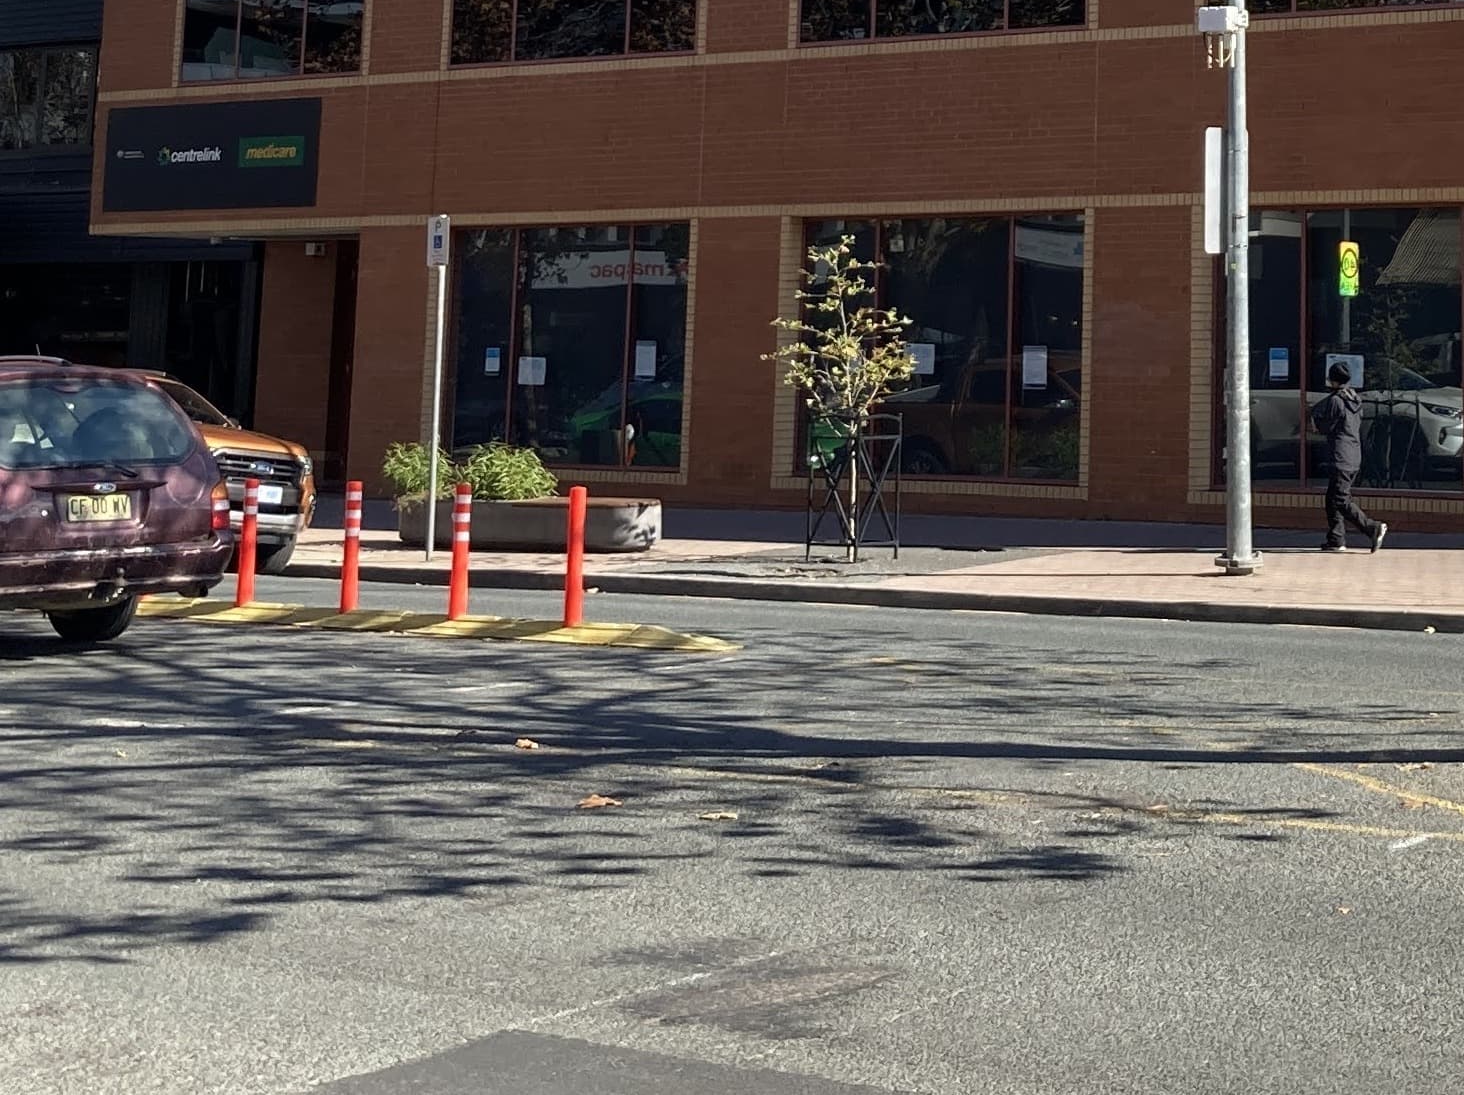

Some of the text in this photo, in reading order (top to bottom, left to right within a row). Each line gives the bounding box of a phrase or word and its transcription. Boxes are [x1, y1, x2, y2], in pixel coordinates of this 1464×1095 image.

[170, 147, 222, 163] centrelink
[246, 144, 297, 160] medicare
[70, 498, 87, 515] CF
